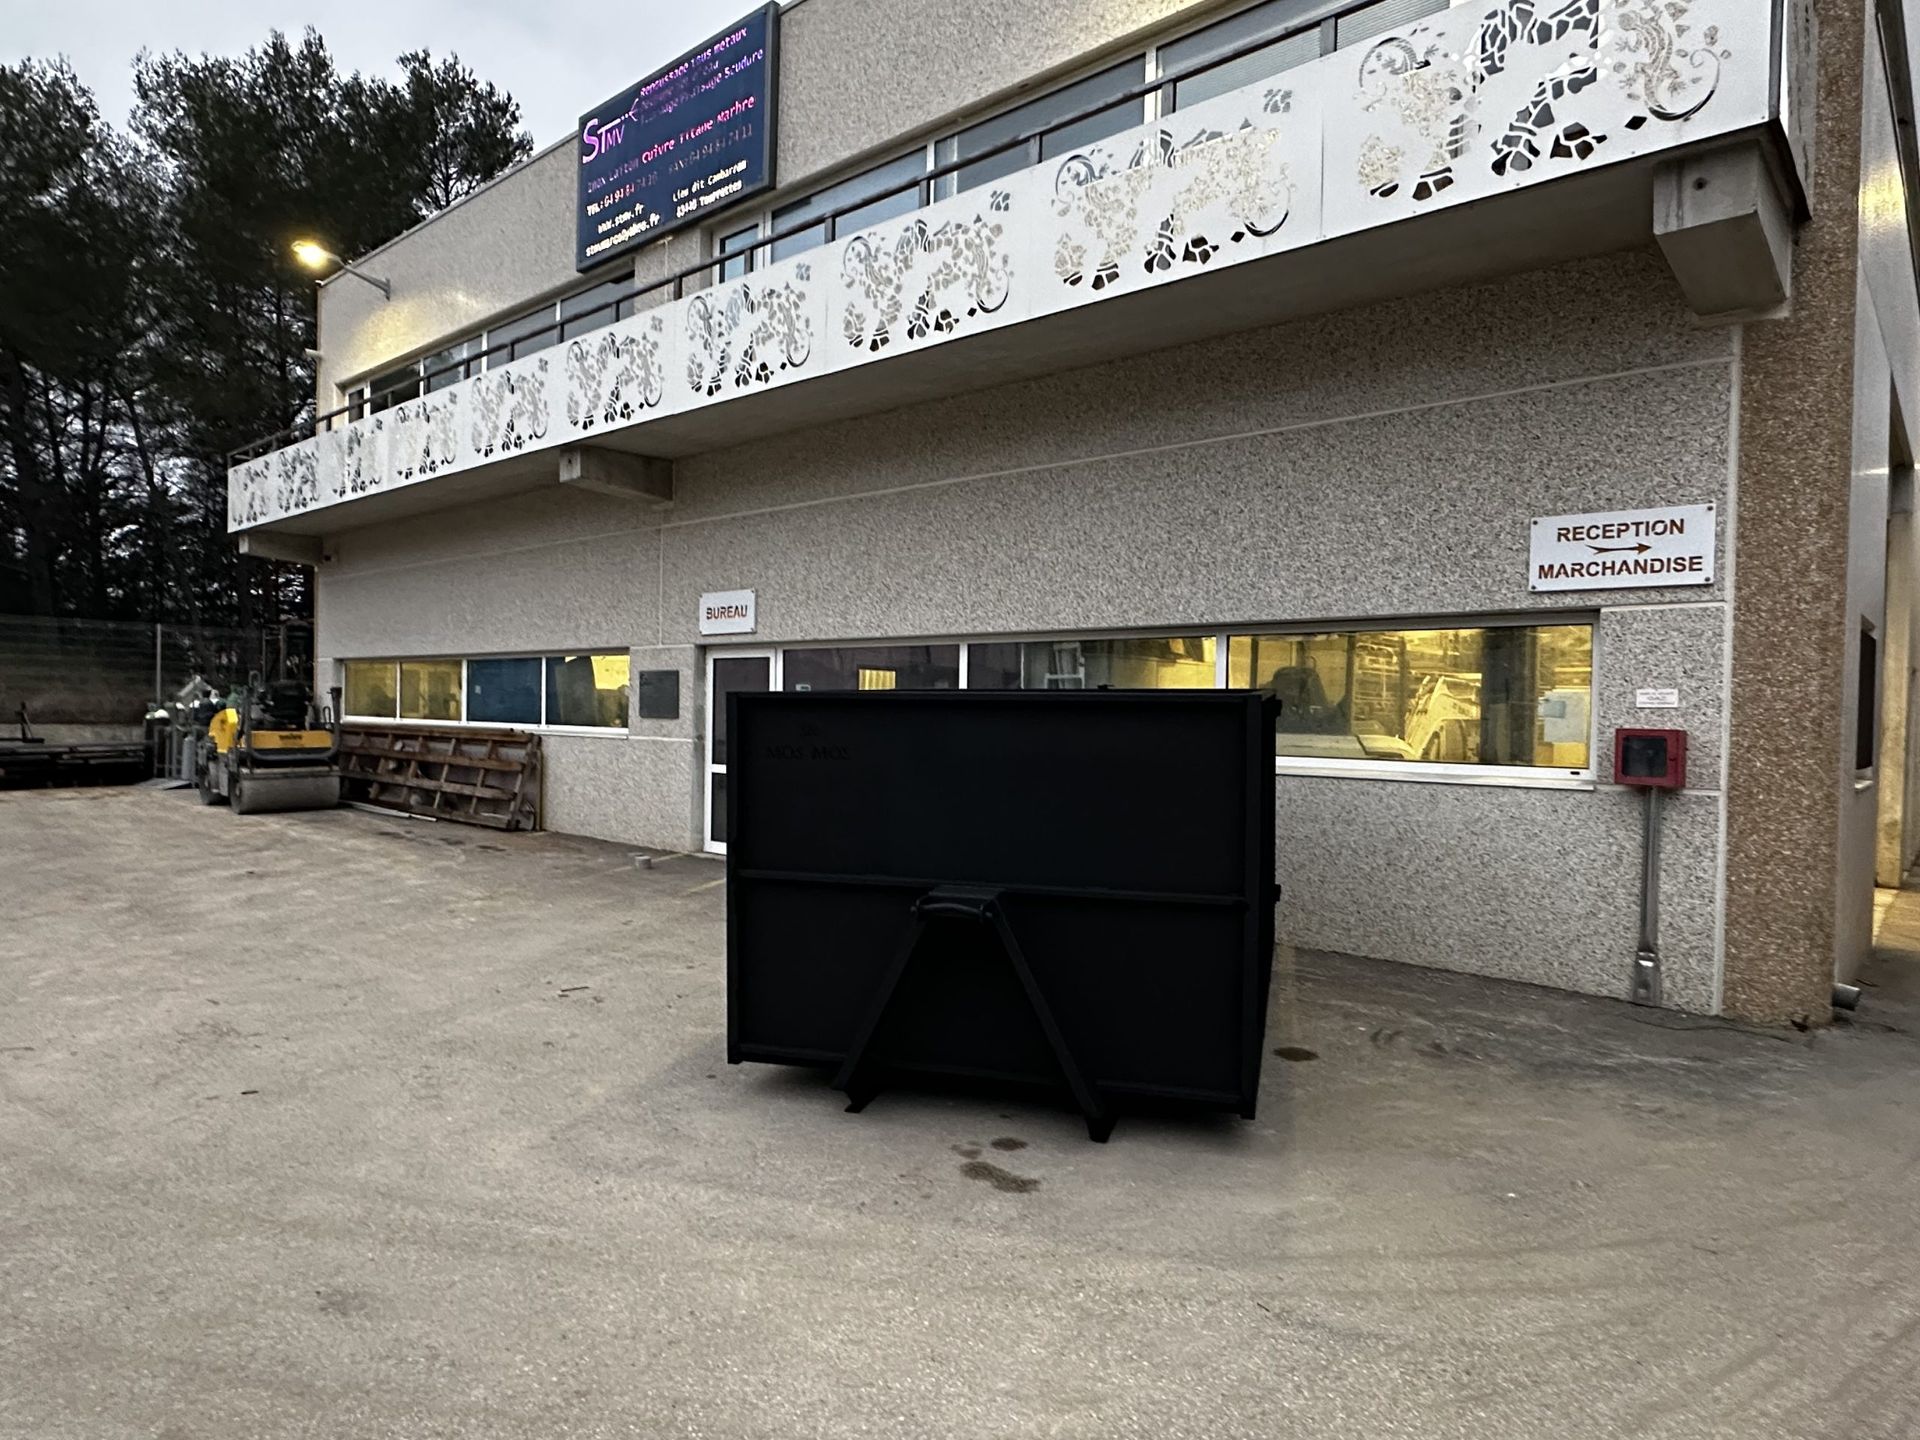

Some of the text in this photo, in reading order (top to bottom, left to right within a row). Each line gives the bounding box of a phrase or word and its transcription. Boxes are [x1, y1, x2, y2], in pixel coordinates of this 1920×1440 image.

[641, 138, 676, 164] Cuivre
[1556, 518, 1685, 543] RECEPTION
[1538, 555, 1704, 580] MARCHANDISE
[706, 604, 748, 620] BUREAU
